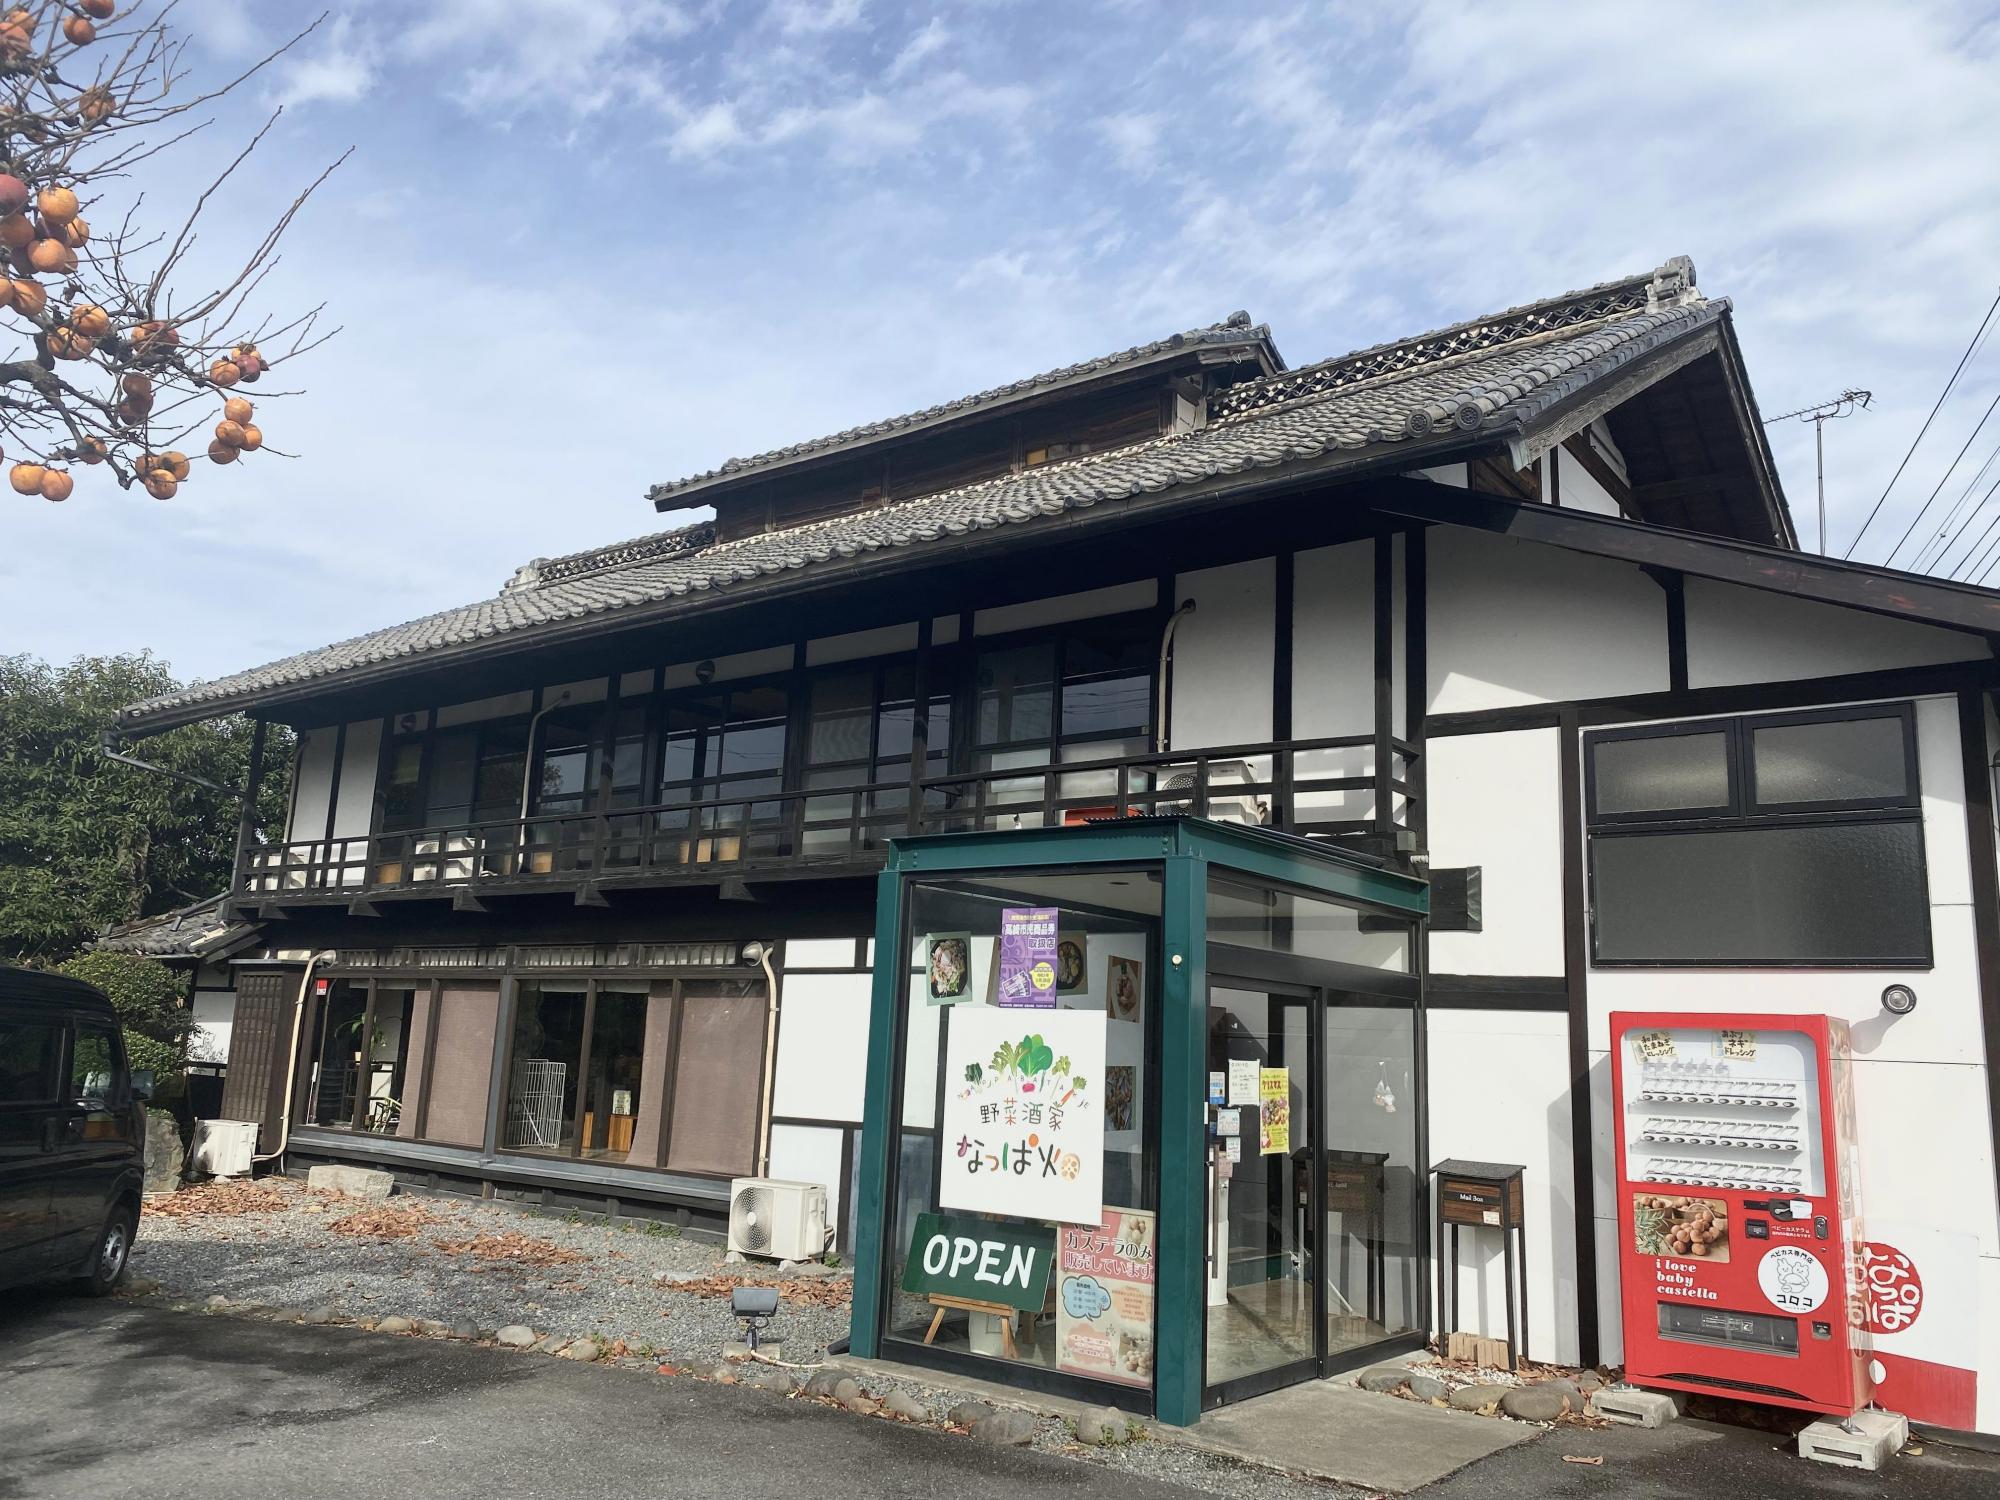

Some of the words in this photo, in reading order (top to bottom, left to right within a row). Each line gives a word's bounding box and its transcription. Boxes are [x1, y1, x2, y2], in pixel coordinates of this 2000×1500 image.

[1028, 938, 1056, 949] 取扱店
[1728, 1039, 1749, 1048] ネギ
[1724, 1046, 1757, 1057] ドレッシング
[980, 1096, 1064, 1131] 野菜酒家
[1064, 1231, 1153, 1259] カステラのみ
[923, 1234, 1036, 1289] OPEN
[1771, 1250, 1813, 1264] ベビカス専門店
[1064, 1251, 1153, 1279] 販売しています
[1656, 1258, 1661, 1269] i
[1665, 1259, 1697, 1273] love
[1656, 1270, 1694, 1288] baby
[1656, 1285, 1718, 1300] castella
[1776, 1294, 1813, 1307] コロコ
